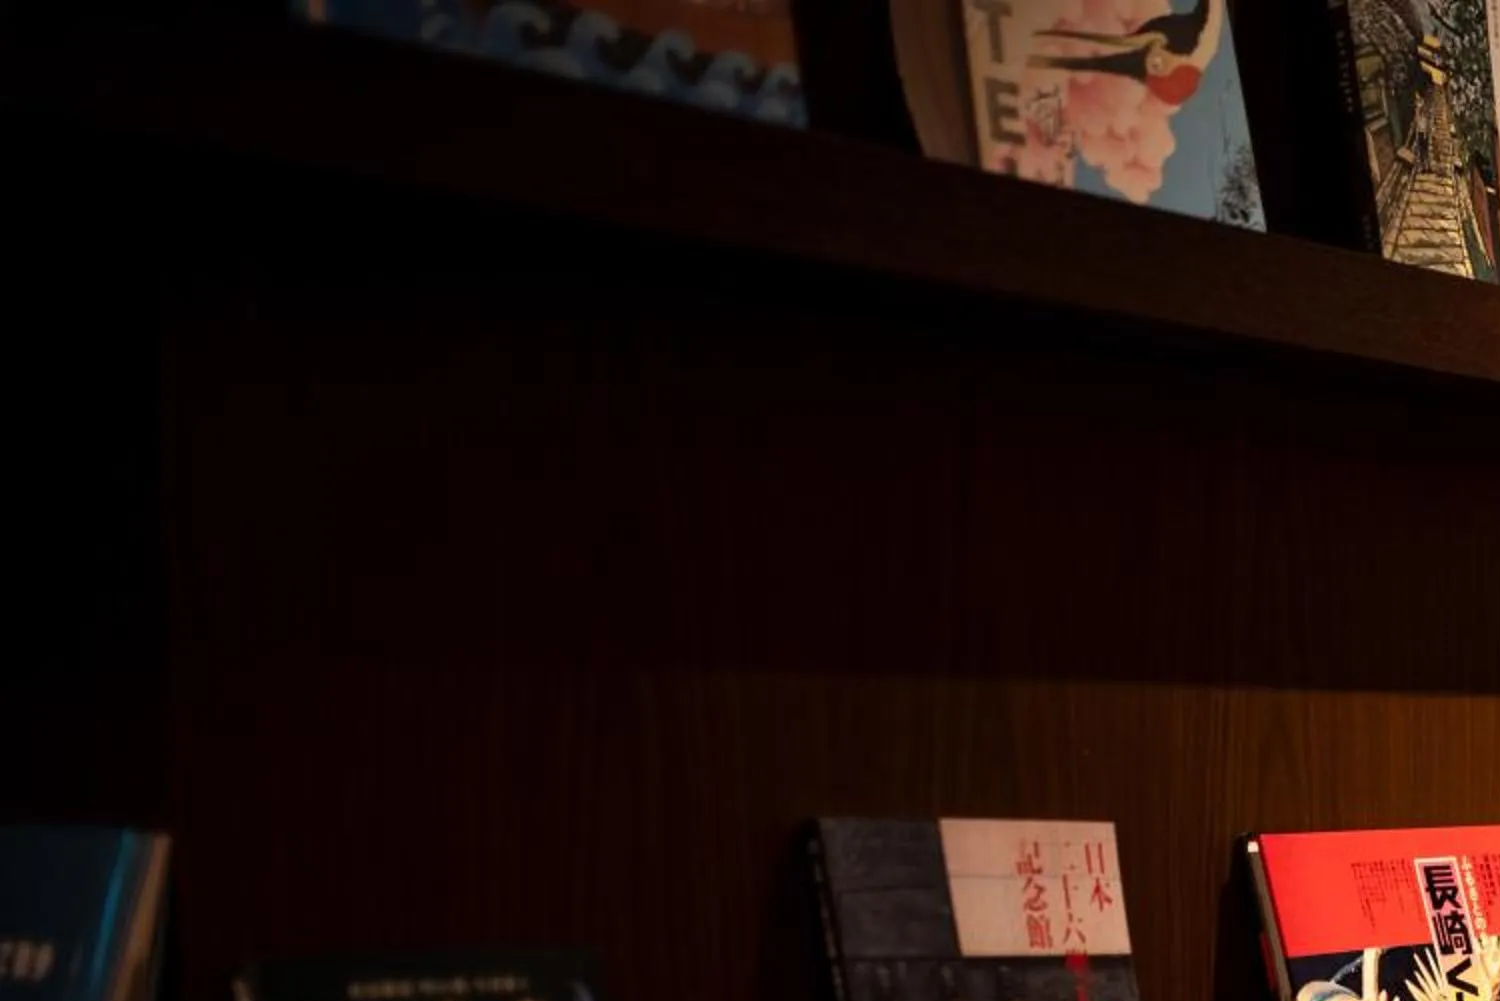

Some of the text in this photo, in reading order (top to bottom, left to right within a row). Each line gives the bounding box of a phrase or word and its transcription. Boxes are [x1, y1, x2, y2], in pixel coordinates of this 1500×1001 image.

[1015, 841, 1054, 951] 記念館
[1083, 842, 1114, 912] 日本
